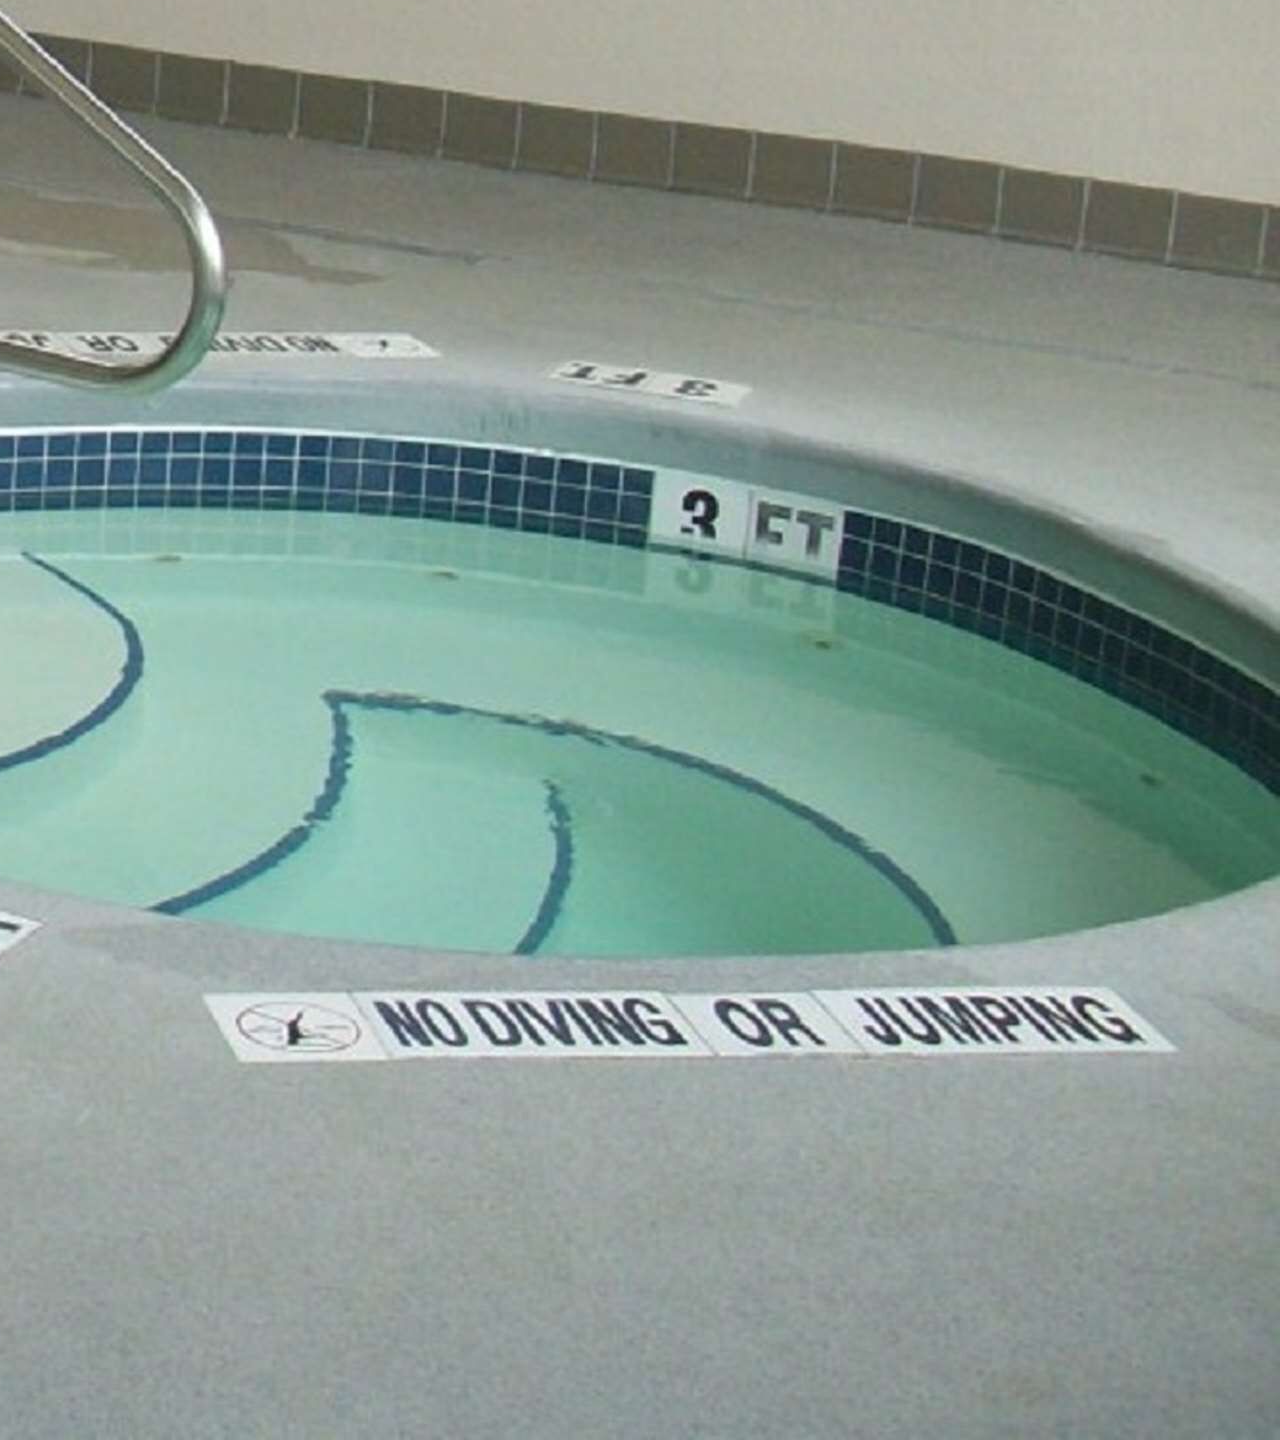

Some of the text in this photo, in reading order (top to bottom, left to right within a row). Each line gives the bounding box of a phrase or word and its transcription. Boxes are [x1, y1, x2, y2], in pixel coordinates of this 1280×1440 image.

[673, 378, 719, 397] 3
[372, 994, 1146, 1048] NO DIVING OR JUMPING
